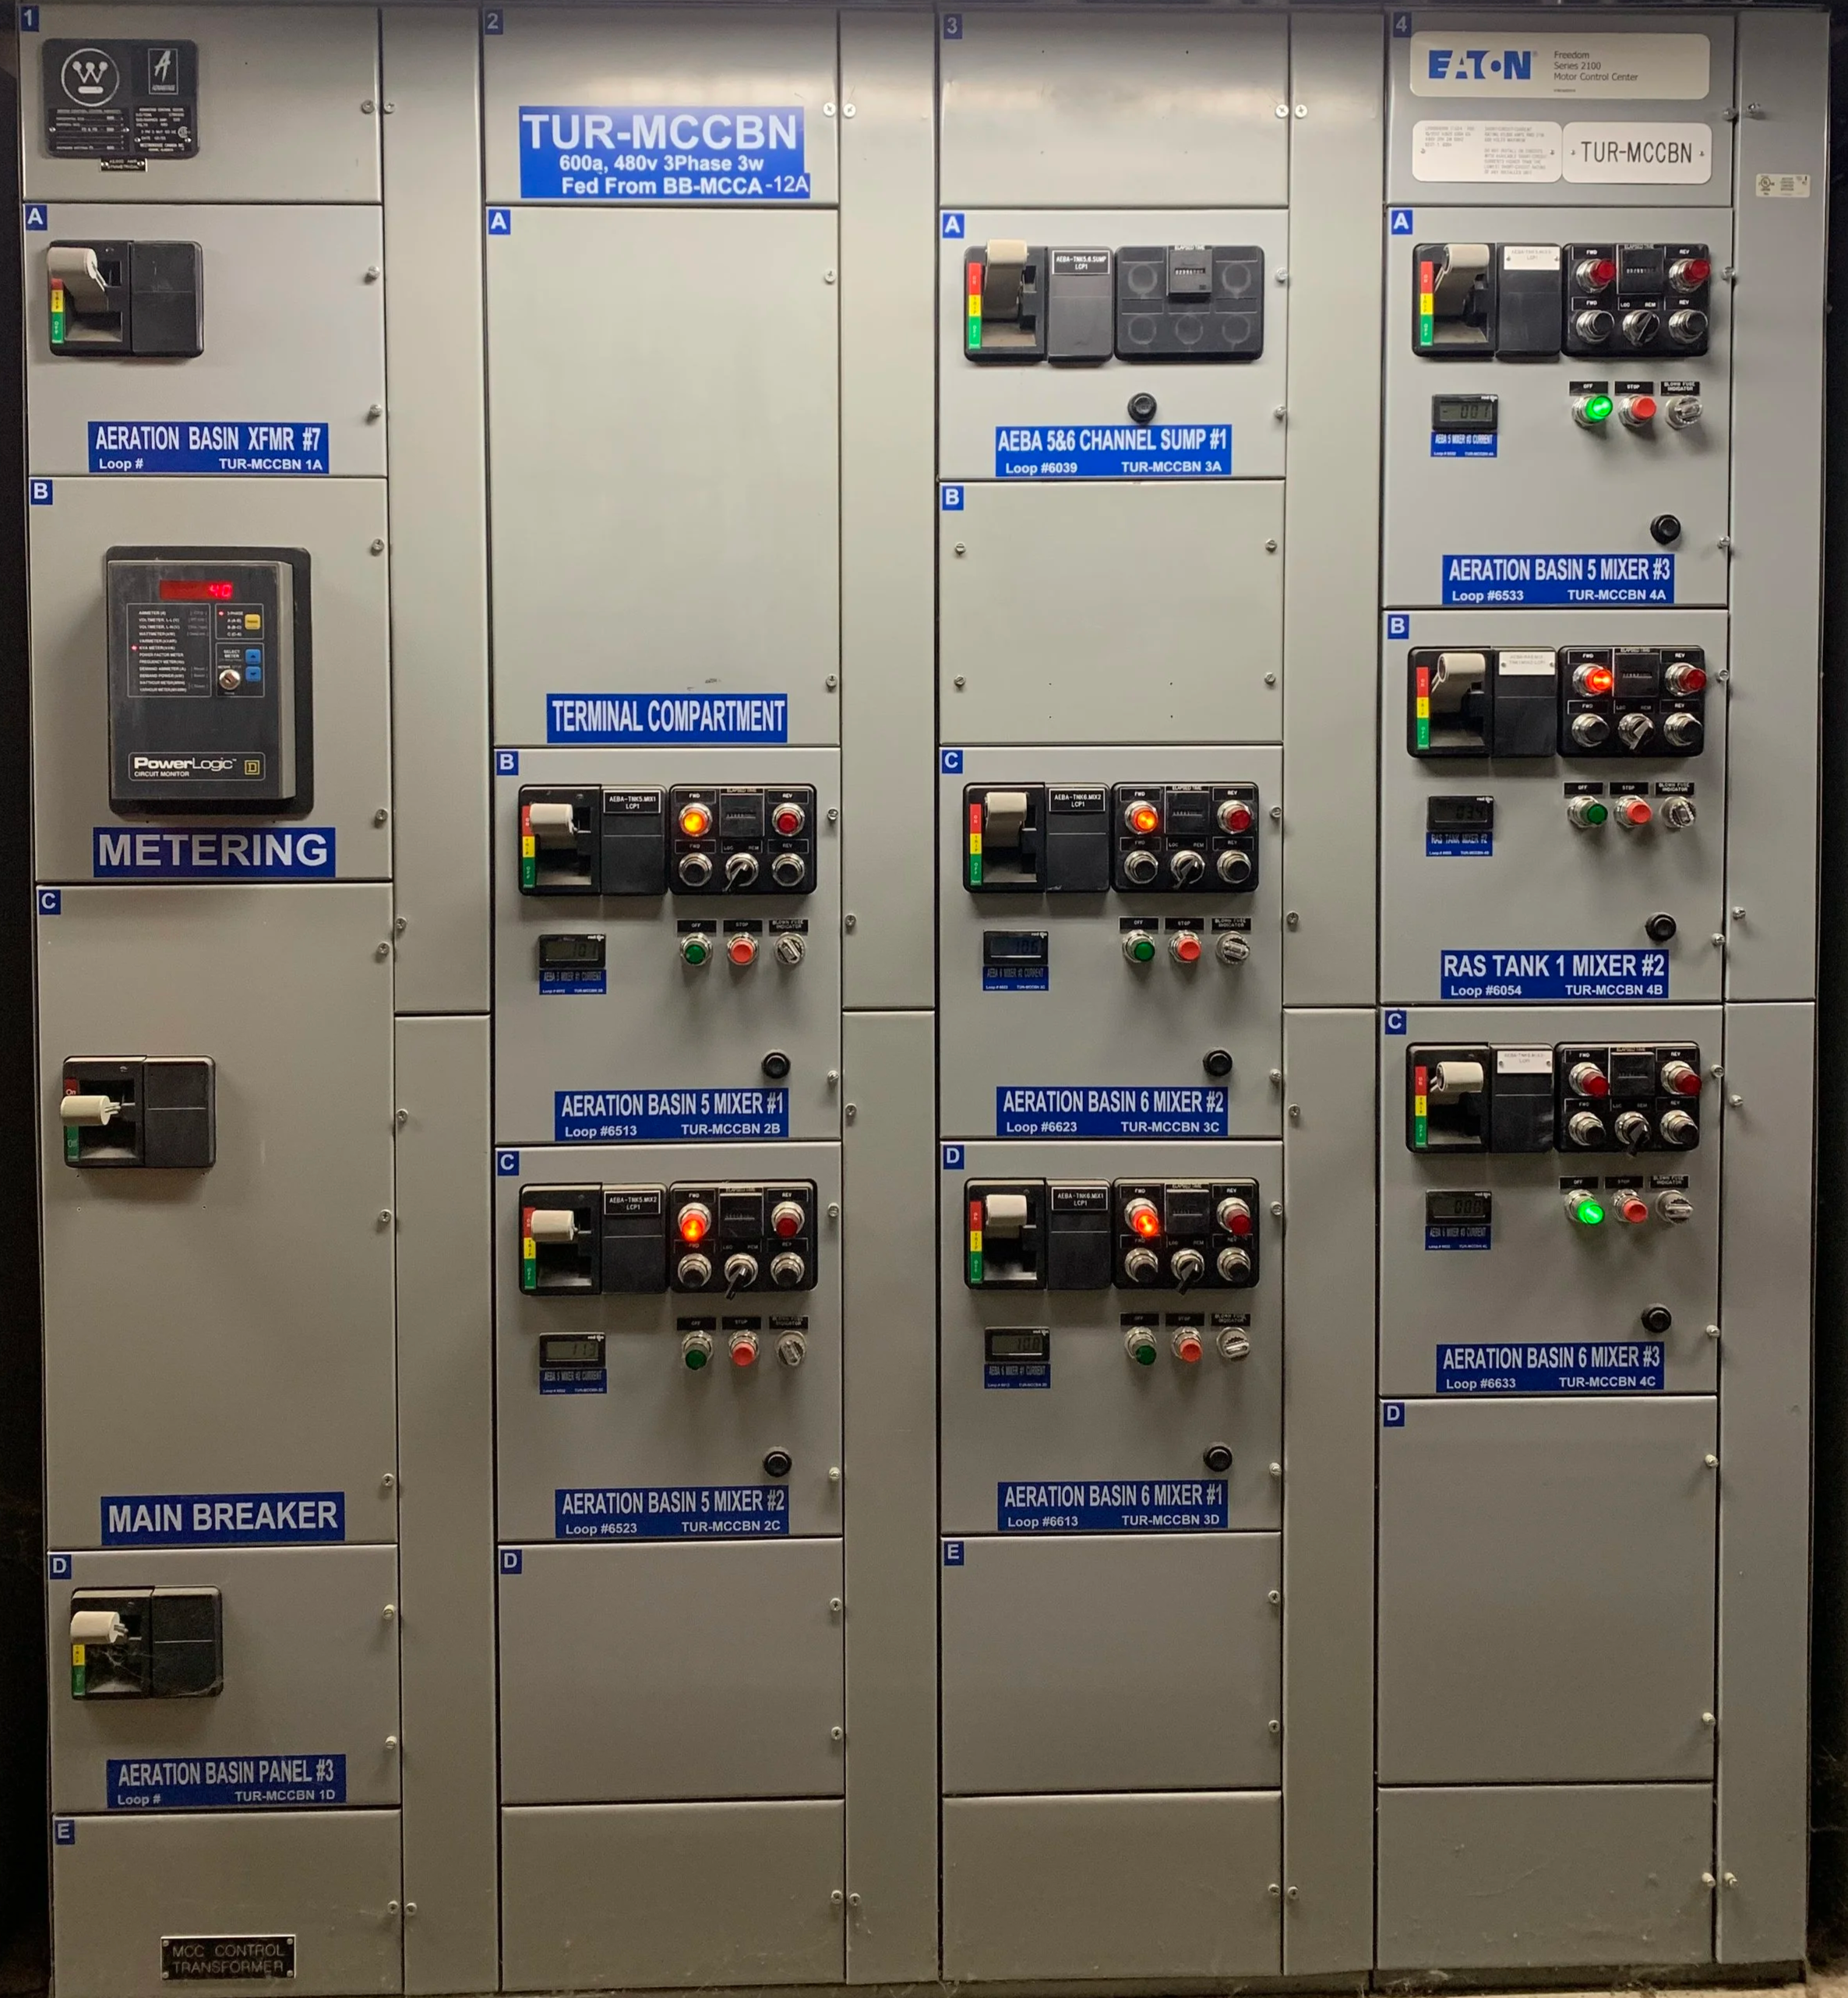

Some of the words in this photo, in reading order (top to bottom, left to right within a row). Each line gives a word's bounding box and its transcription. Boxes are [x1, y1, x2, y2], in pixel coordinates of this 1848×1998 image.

[24, 9, 32, 26] 1
[487, 12, 499, 29] 2
[947, 17, 958, 34] 3
[1396, 16, 1407, 32] 4
[1554, 51, 1589, 59] Freedom
[1429, 50, 1531, 79] EATON
[1554, 62, 1578, 70] Series
[1581, 62, 1601, 70] 2100
[1579, 72, 1609, 81] Control
[1611, 72, 1638, 81] Center
[523, 114, 796, 150] TUR-MCCBN
[1581, 141, 1691, 164] TUR-MCCBN
[559, 154, 608, 174] 600a,
[614, 154, 658, 171] 480v
[664, 154, 732, 171] 3Phase
[738, 155, 764, 171] 3w
[563, 177, 598, 194] Fed
[605, 177, 657, 195] From
[27, 208, 43, 224] A
[491, 212, 506, 229] A
[944, 215, 960, 233] A
[1393, 213, 1409, 229] A
[96, 426, 179, 450] AERATION
[189, 426, 238, 450] BASIN
[249, 427, 294, 450] XFMR
[302, 427, 321, 451] #7
[998, 430, 1042, 451] AEBA
[1047, 429, 1075, 451] 5&6
[1080, 428, 1156, 451] CHANNEL
[1161, 428, 1206, 450] SUMP
[1210, 428, 1226, 449] #1
[100, 458, 132, 471] Loop
[135, 458, 143, 469] #
[219, 458, 302, 470] TUR-MCCBN
[305, 460, 323, 470] 1A
[1006, 463, 1037, 475] Loop
[1041, 463, 1077, 473] #6039
[1122, 461, 1201, 473] TUR-MCCBN
[1205, 461, 1222, 472] 3A
[34, 482, 48, 499] B
[946, 488, 959, 505] B
[1449, 559, 1530, 580] AERATION
[1535, 559, 1582, 580] BASIN
[1587, 559, 1596, 580] 5
[1601, 559, 1649, 580] MIXER
[1652, 558, 1670, 580] #3
[1452, 590, 1484, 604] Loop
[1487, 590, 1524, 601] #6533
[1568, 590, 1646, 600] TUR-MCCBN
[1649, 590, 1666, 600] 4A
[1391, 618, 1405, 633] B
[552, 700, 644, 731] TERMINAL
[648, 700, 785, 731] COMPARTMENT
[134, 757, 233, 771] PowerLogic
[500, 753, 514, 770] B
[944, 752, 958, 768] C
[100, 833, 327, 866] METERING
[41, 893, 55, 909] C
[1444, 955, 1487, 977] RAS
[1492, 955, 1550, 977] TANK
[1557, 955, 1564, 976] 1
[1573, 954, 1637, 976] MIXER
[1642, 954, 1664, 976] #2
[1451, 985, 1483, 998] Loop
[1486, 985, 1522, 995] #6054
[1565, 985, 1643, 995] TUR-MCCBN
[1646, 985, 1663, 995] 4B
[1388, 1013, 1402, 1029] C
[562, 1094, 643, 1117] AERATION
[648, 1093, 696, 1115] BASIN
[701, 1093, 710, 1115] 5
[714, 1092, 764, 1114] MIXER
[767, 1092, 782, 1114] #1
[1003, 1091, 1083, 1112] AERATION
[1088, 1091, 1136, 1112] BASIN
[1141, 1091, 1149, 1112] 6
[1154, 1091, 1202, 1112] MIXER
[1206, 1091, 1223, 1112] #2
[566, 1126, 597, 1139] Loop
[600, 1126, 637, 1136] #6513
[681, 1123, 760, 1135] TUR-MCCBN
[764, 1123, 781, 1133] 2B
[1007, 1122, 1038, 1134] Loop
[1041, 1122, 1077, 1132] #6623
[1121, 1122, 1199, 1132] TUR-MCCBN
[1204, 1122, 1219, 1133] 3C
[500, 1154, 514, 1170] C
[947, 1147, 960, 1163] D
[1443, 1348, 1522, 1369] AERATION
[1527, 1347, 1574, 1368] BASIN
[1578, 1347, 1587, 1368] 6
[1592, 1346, 1639, 1367] MIXER
[1643, 1345, 1659, 1367] #3
[1447, 1379, 1477, 1391] Loop
[1480, 1378, 1516, 1388] #6633
[1559, 1376, 1636, 1387] TUR-MCCBN
[1640, 1376, 1656, 1387] 4C
[1387, 1405, 1400, 1421] D
[563, 1492, 643, 1514] AERATION
[648, 1491, 696, 1513] BASIN
[701, 1491, 710, 1512] 5
[714, 1490, 763, 1512] MIXER
[767, 1489, 785, 1511] #2
[1004, 1485, 1084, 1507] AERATION
[1090, 1485, 1136, 1506] BASIN
[1141, 1485, 1150, 1506] 6
[1155, 1484, 1203, 1506] MIXER
[1207, 1484, 1222, 1505] #1
[109, 1504, 182, 1533] MAIN
[193, 1501, 338, 1531] BREAKER
[1008, 1517, 1039, 1529] Loop
[1042, 1516, 1078, 1527] #6613
[1122, 1514, 1200, 1525] TUR-MCCBN
[1204, 1514, 1219, 1524] 3D
[566, 1524, 598, 1536] Loop
[601, 1523, 637, 1534] #6523
[682, 1521, 760, 1532] TUR-MCCBN
[764, 1521, 780, 1531] 2C
[947, 1544, 959, 1559] E
[53, 1558, 66, 1573] D
[504, 1552, 517, 1568] D
[118, 1762, 200, 1786] AERATION
[206, 1761, 254, 1784] BASIN
[259, 1760, 312, 1784] PANEL
[316, 1759, 333, 1781] #3
[118, 1795, 150, 1806] Loop
[153, 1794, 160, 1804] #
[235, 1790, 315, 1802] TUR-MCCBN
[319, 1789, 335, 1800] 1D
[58, 1823, 70, 1838] E
[174, 1945, 205, 1957] MCC
[215, 1944, 286, 1957] CONTROL
[172, 1961, 283, 1973] TRANSFORMER
